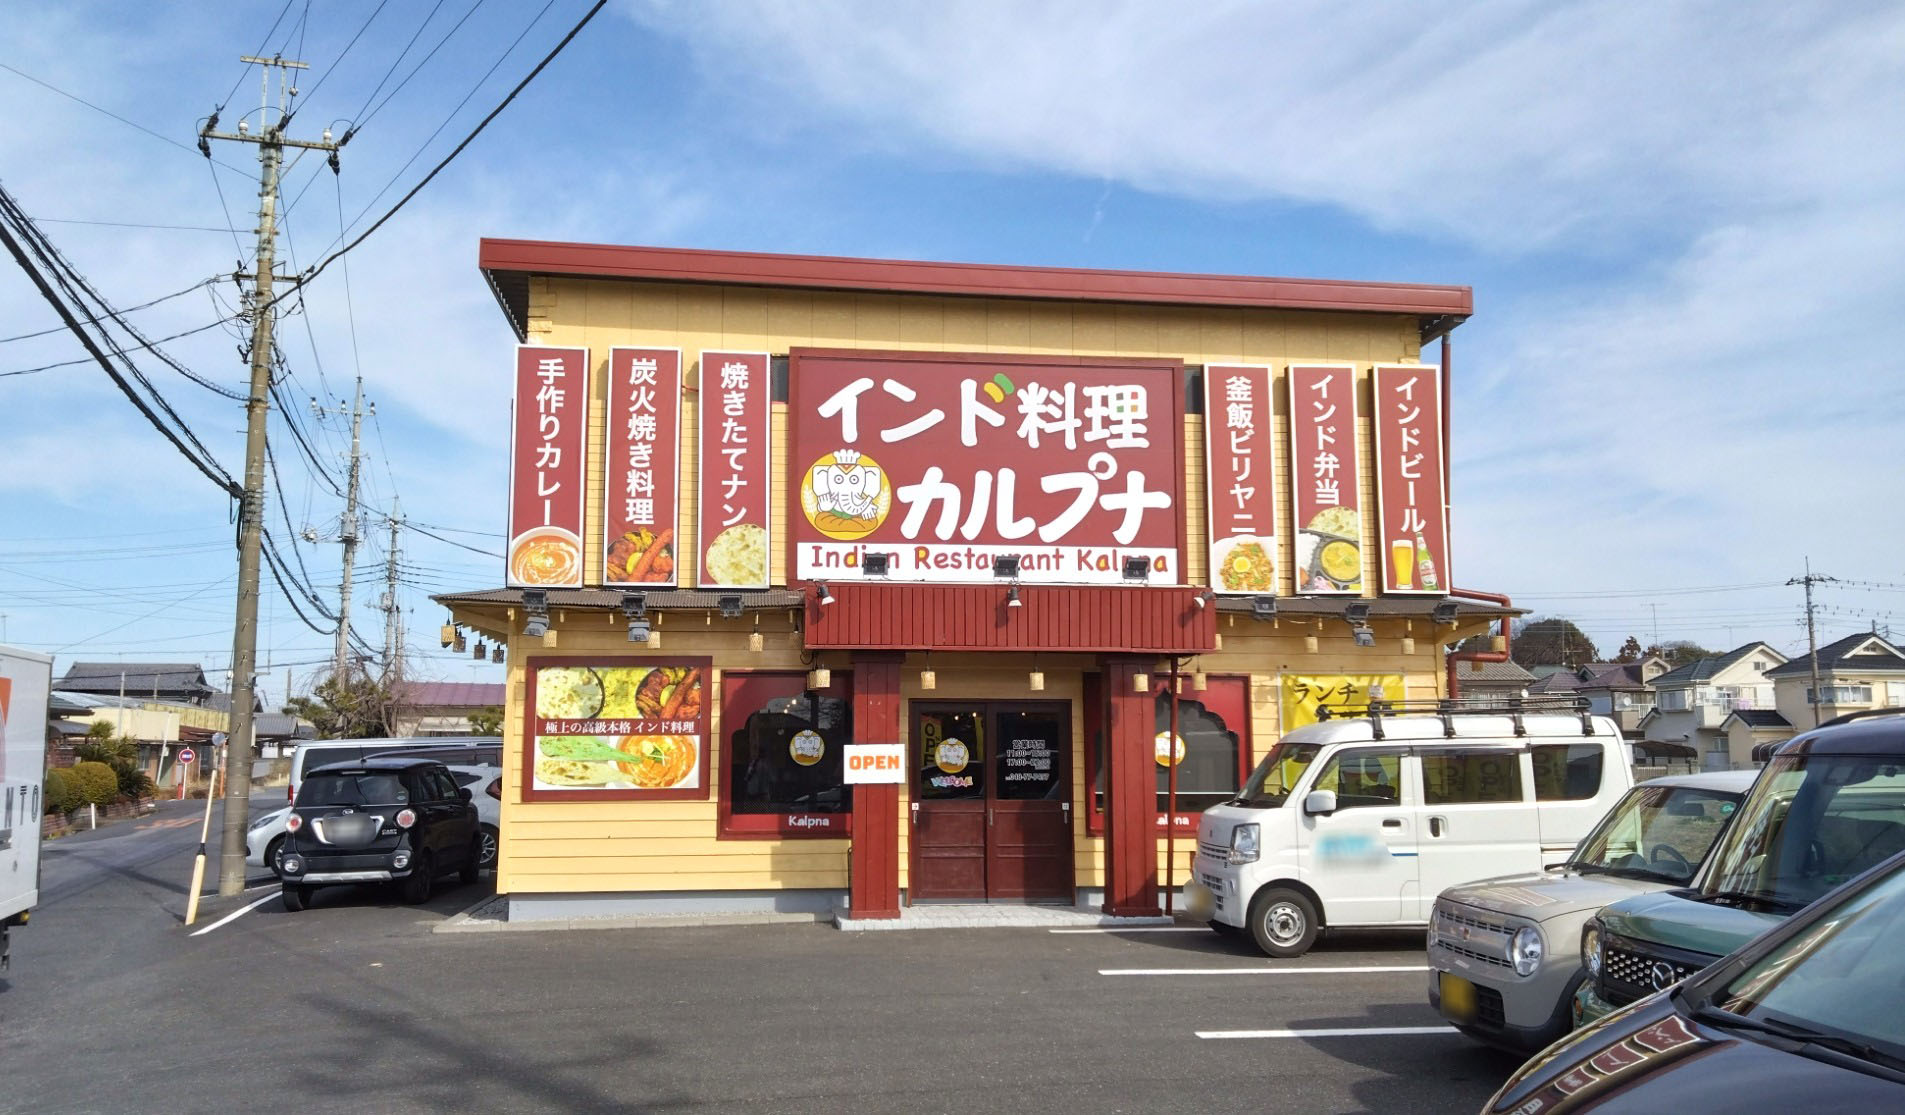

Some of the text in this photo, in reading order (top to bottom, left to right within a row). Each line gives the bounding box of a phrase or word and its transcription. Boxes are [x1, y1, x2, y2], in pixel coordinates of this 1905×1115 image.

[535, 357, 566, 526] 手作りカレー
[625, 357, 658, 525] 炭火焼き料理
[719, 361, 749, 527] 焼きたてナン
[817, 373, 1150, 450] インド料理
[1310, 374, 1341, 506] インド弁当
[1225, 376, 1256, 533] 釜飯ビリヤニ
[1395, 376, 1427, 533] インドビール
[897, 451, 1172, 545] カルプナ
[811, 544, 900, 569] Indin
[914, 546, 1064, 571] Restaant
[545, 721, 695, 734] 極上の高級本格 インド料理
[1294, 682, 1359, 705] ランチ
[849, 755, 900, 770] OPEN
[788, 814, 830, 829] Kalpna
[1156, 813, 1190, 826] alna
